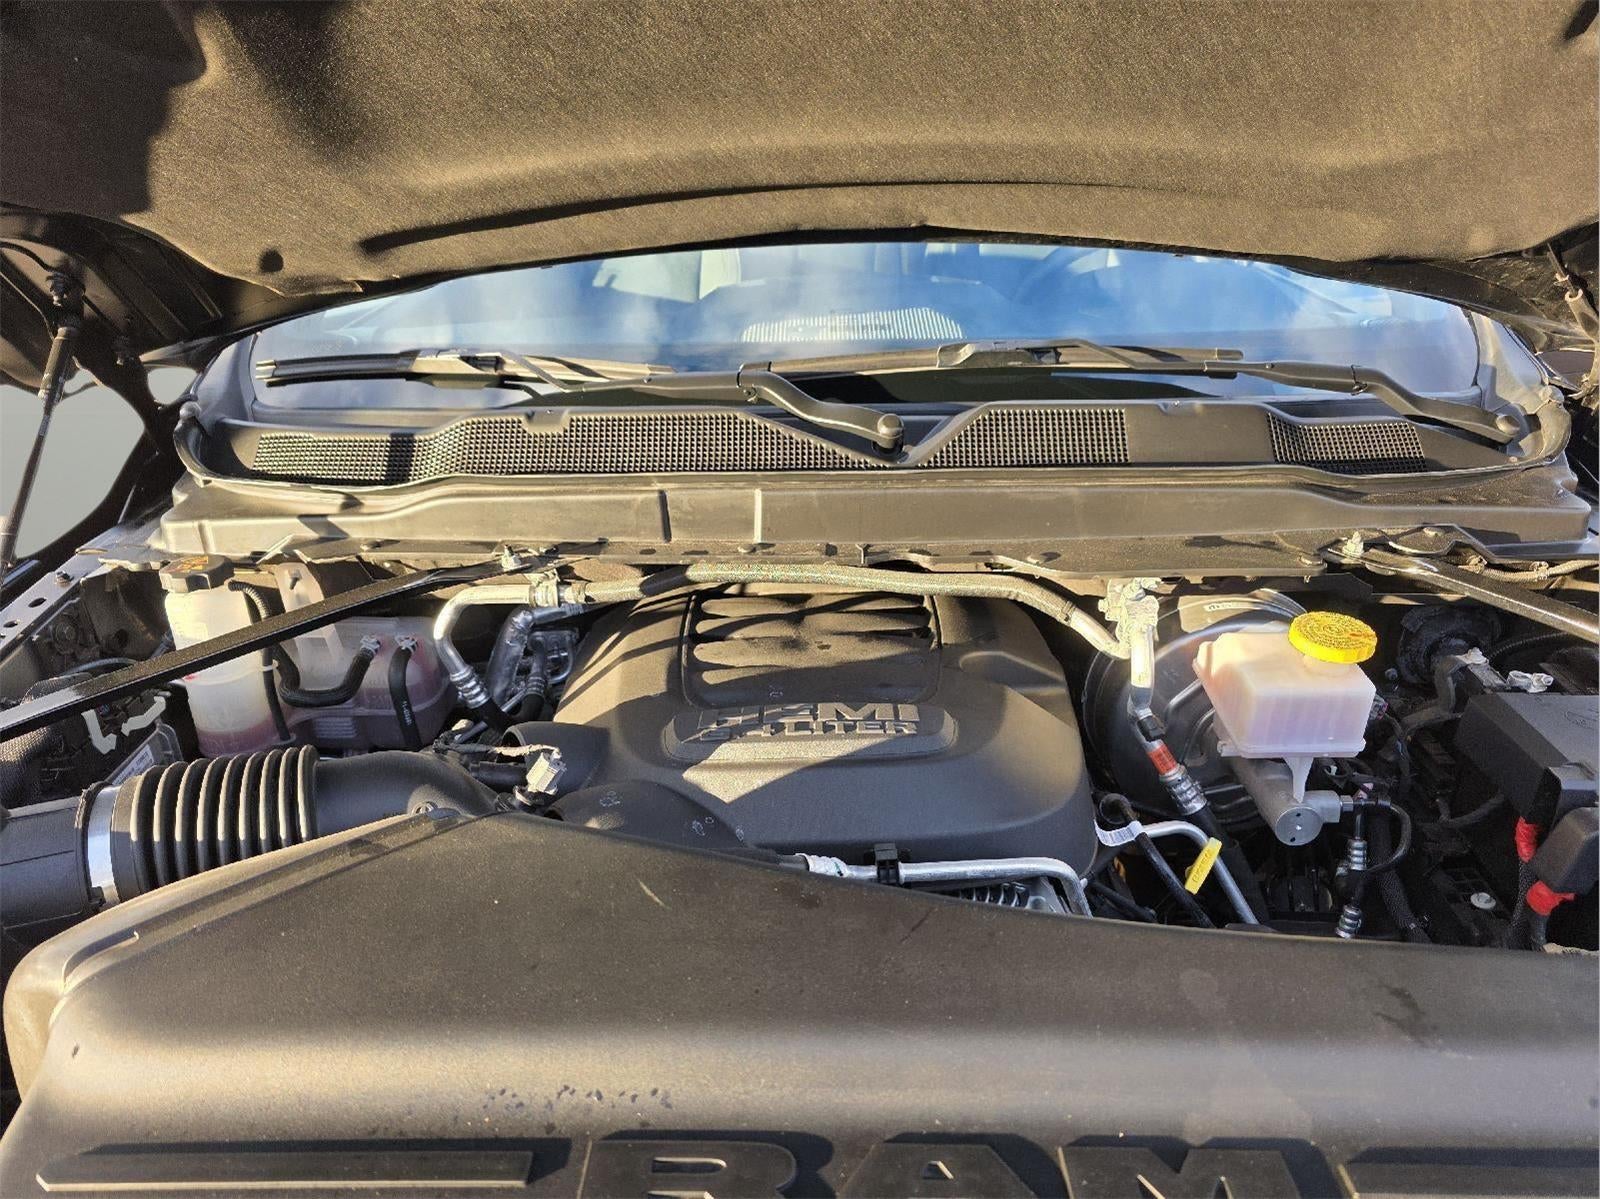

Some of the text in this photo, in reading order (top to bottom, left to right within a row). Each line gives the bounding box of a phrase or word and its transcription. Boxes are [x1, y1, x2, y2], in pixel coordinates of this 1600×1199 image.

[697, 702, 920, 729] HEMI
[784, 720, 918, 735] LITER
[575, 1139, 1304, 1199] RAM
